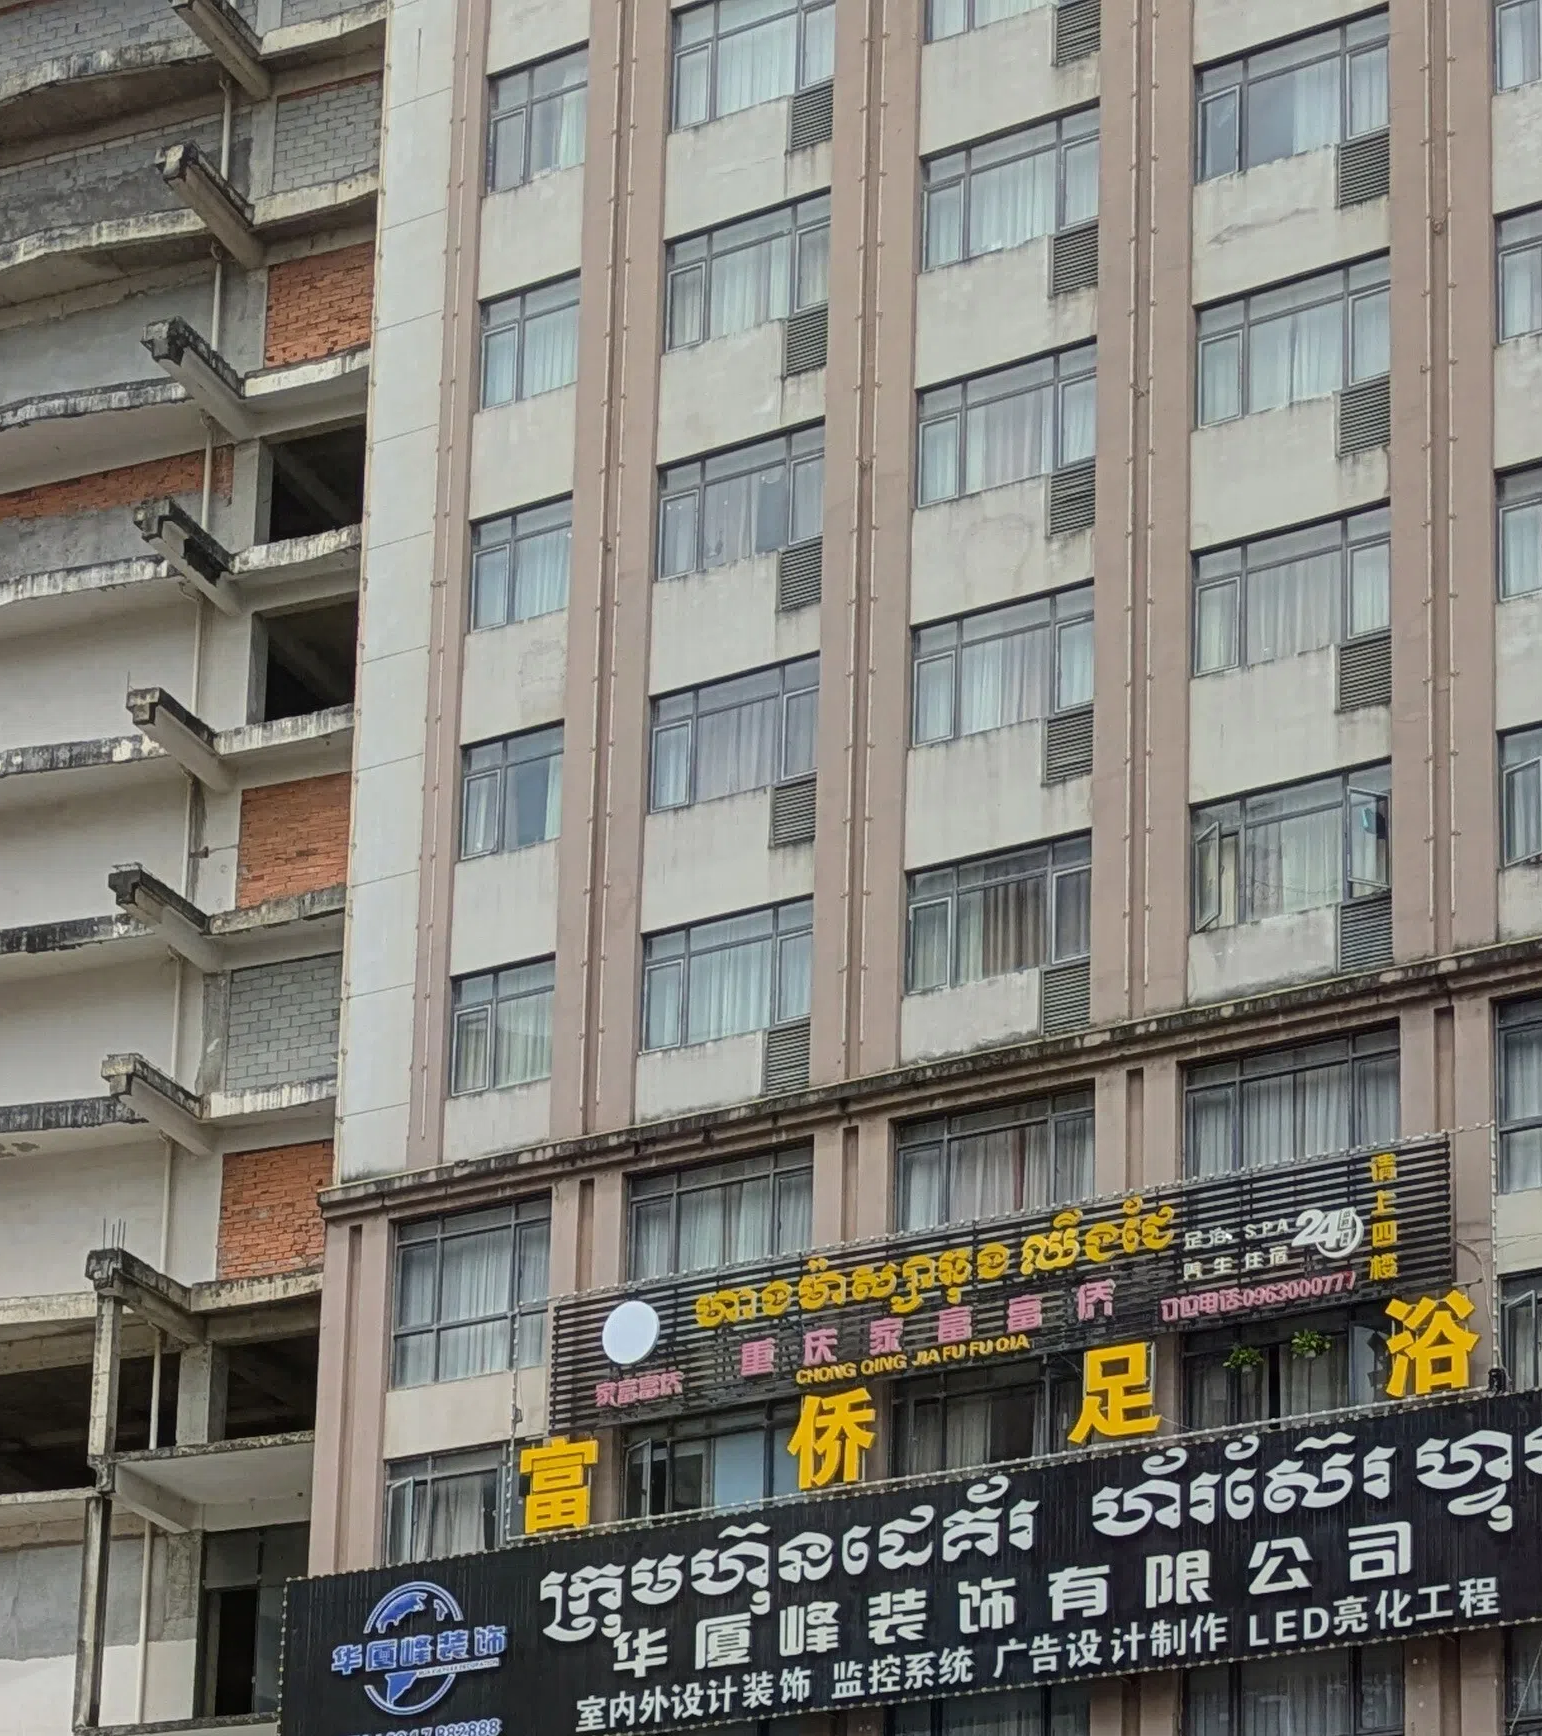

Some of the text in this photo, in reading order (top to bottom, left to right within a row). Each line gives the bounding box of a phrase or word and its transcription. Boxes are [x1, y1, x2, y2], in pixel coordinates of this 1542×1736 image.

[1244, 1218, 1290, 1240] SPA
[740, 1277, 1118, 1378] 重庆家富富侨
[795, 1360, 857, 1385] CHONG
[860, 1354, 908, 1377] QING
[943, 1342, 967, 1362] FU
[969, 1338, 994, 1358] FU
[612, 1521, 1412, 1678] 华厦峰装饰有限公司
[575, 1576, 1501, 1733] 室内外设计装饰 监控系统 广告设计制作 LED亮化工程
